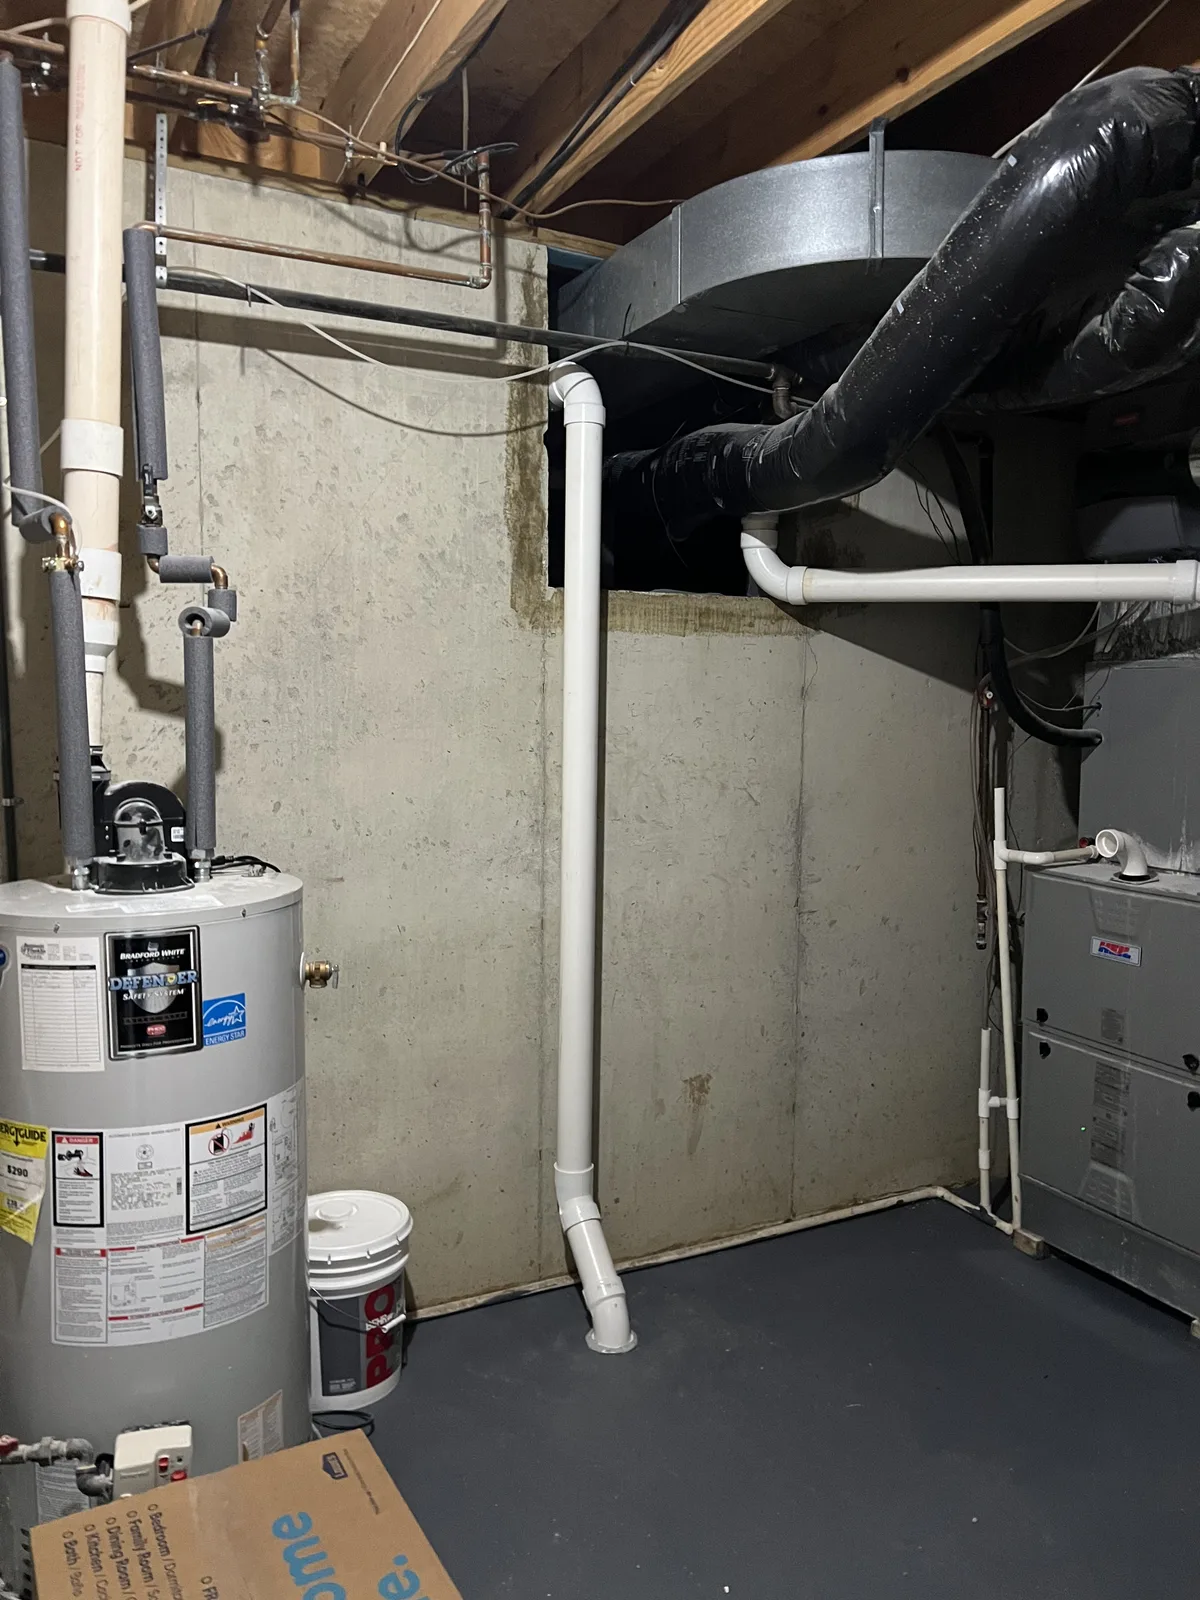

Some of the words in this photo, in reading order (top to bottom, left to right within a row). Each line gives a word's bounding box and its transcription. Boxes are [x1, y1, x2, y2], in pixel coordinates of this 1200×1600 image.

[75, 124, 84, 144] FOR
[75, 150, 83, 171] NOT
[120, 951, 160, 960] BRADFORD
[161, 948, 185, 957] WHITE
[109, 970, 199, 991] DEFENDER
[122, 992, 151, 1001] SAFETY
[154, 988, 185, 997] SYSTEM
[205, 1035, 229, 1045] ENERGY
[230, 1031, 245, 1040] STAR
[7, 1164, 28, 1177] $290
[365, 1284, 395, 1389] PRO
[149, 1511, 171, 1557] Bedroom
[63, 1539, 78, 1565] Bath
[85, 1533, 103, 1573] Kitchen
[107, 1525, 124, 1559] Dining
[116, 1558, 131, 1590] Room
[128, 1519, 145, 1551] Family
[137, 1551, 154, 1583] Room
